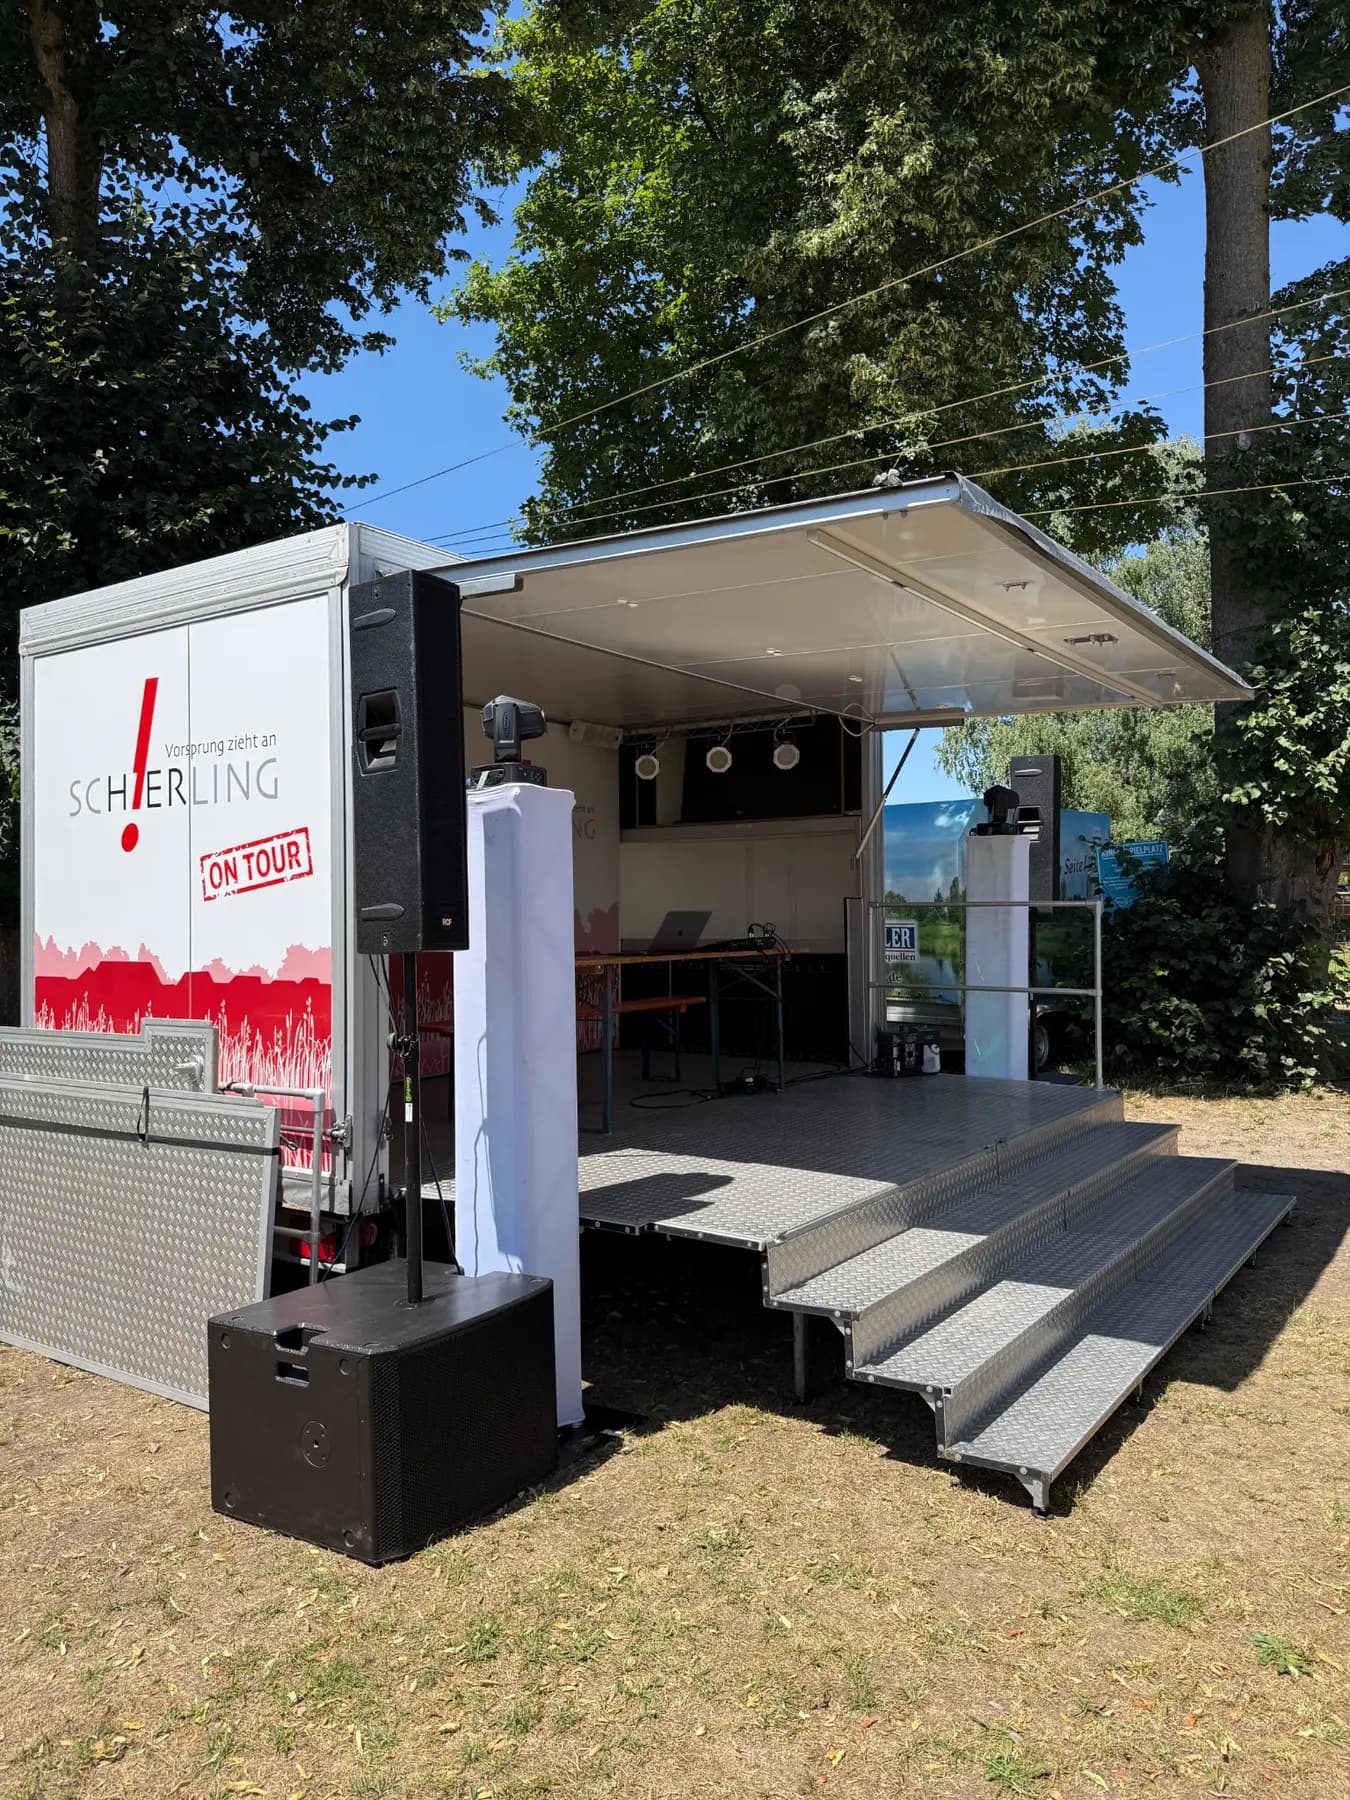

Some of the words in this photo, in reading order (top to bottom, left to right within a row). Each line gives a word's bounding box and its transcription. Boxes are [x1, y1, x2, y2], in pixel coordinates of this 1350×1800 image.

[165, 739, 225, 759] Vorsprung
[227, 733, 258, 752] zieht
[261, 733, 277, 747] an
[209, 855, 239, 890] ON
[242, 840, 302, 881] TOUR
